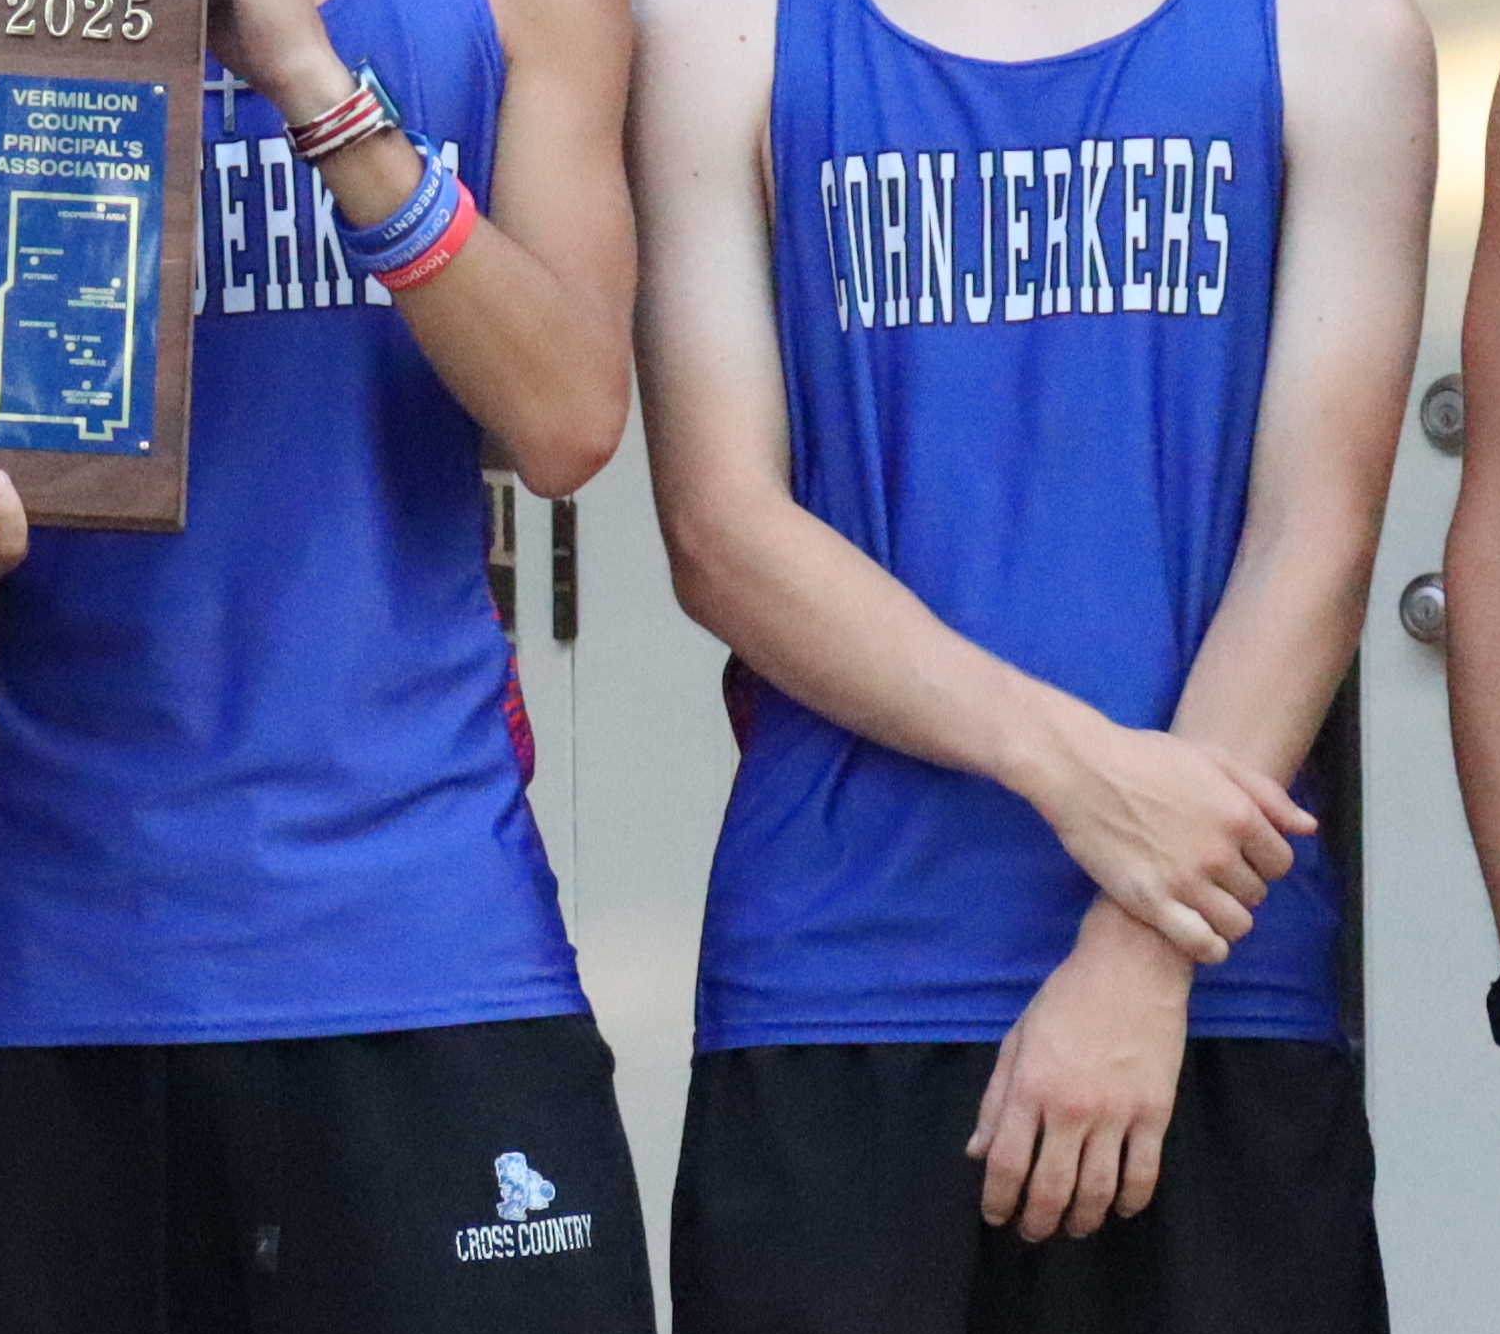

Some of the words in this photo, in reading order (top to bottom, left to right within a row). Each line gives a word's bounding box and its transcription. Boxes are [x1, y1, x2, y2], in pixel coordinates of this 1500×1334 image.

[12, 88, 138, 112] VERMILION
[26, 113, 123, 135] COUNTY
[3, 134, 144, 158] PRINCIPAL'S
[820, 137, 1234, 334] CORNJERKERS
[455, 1224, 515, 1262] CROSS
[517, 1213, 592, 1257] COUNTRY
